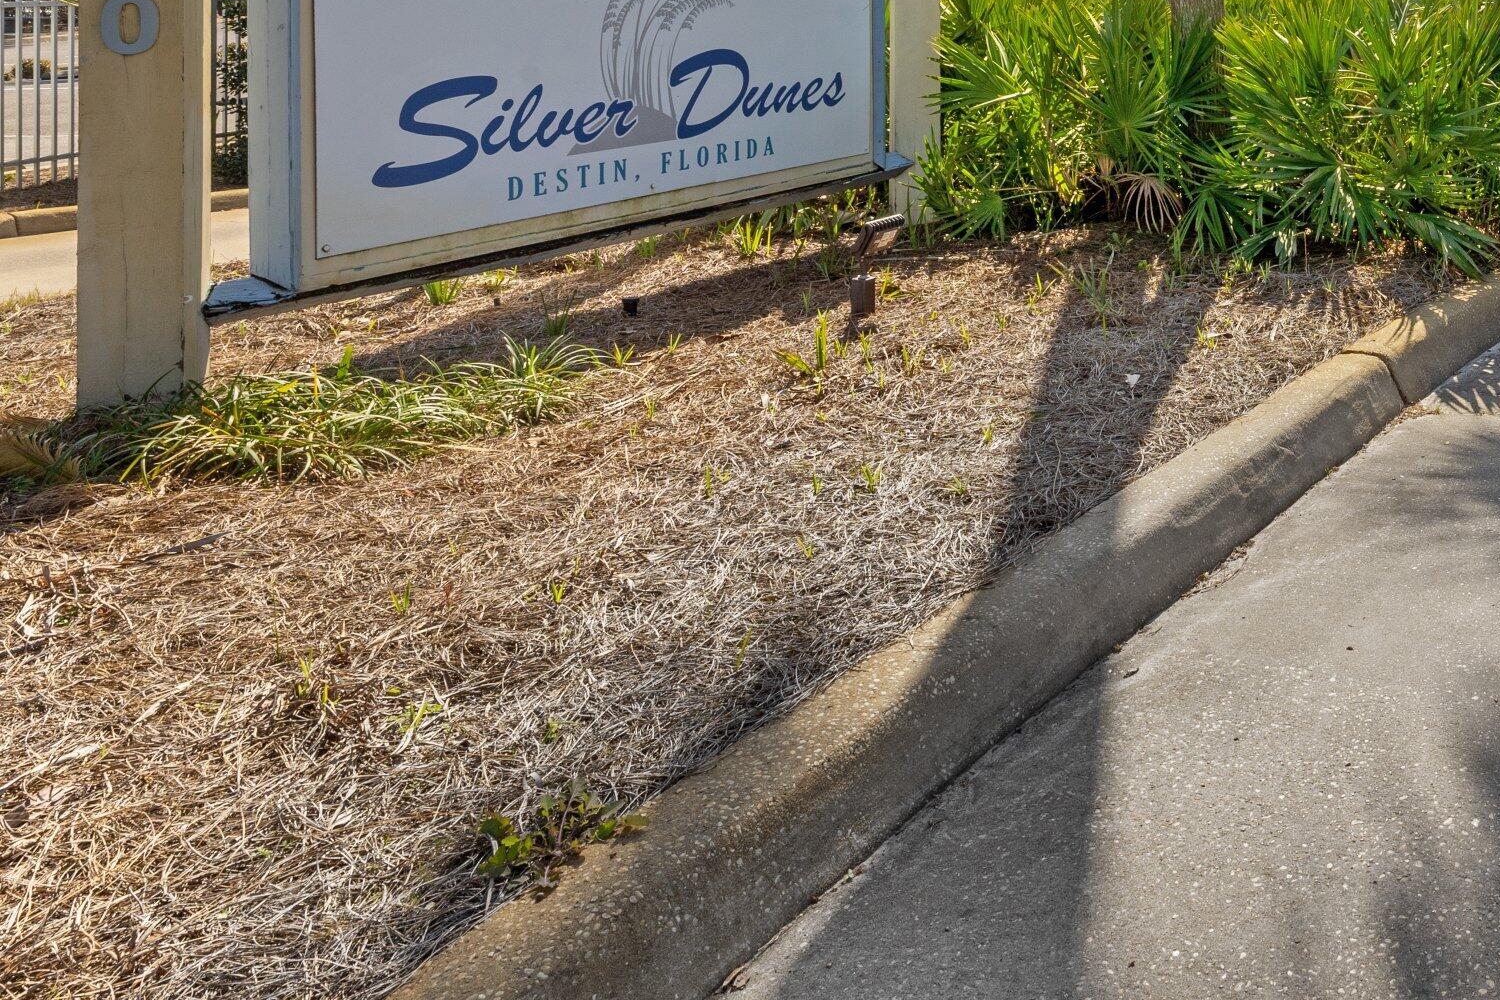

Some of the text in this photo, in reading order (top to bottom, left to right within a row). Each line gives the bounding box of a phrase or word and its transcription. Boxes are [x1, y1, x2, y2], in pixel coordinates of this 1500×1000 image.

[372, 48, 846, 188] Silver Dunes
[507, 135, 775, 202] DESTIN, FLORIDA
